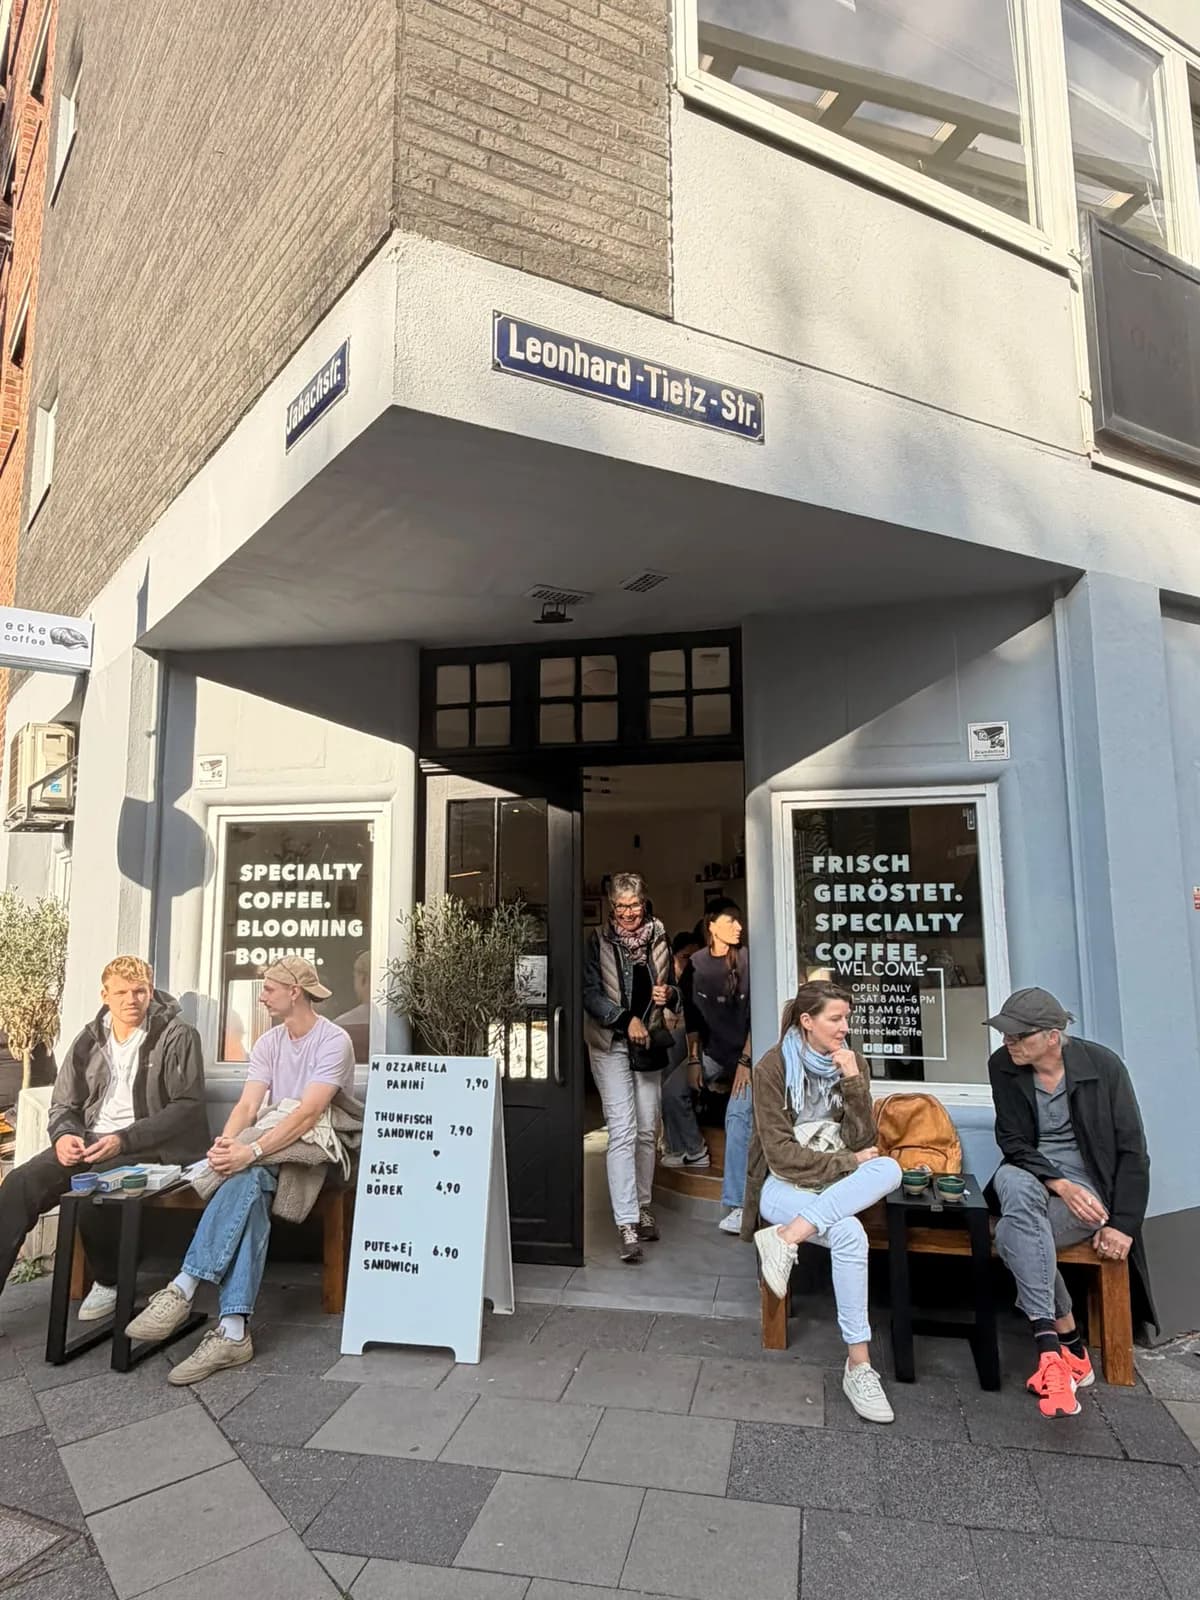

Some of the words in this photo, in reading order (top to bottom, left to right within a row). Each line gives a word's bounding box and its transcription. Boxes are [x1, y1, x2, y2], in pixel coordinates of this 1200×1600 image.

[509, 322, 758, 429] Leonhard-Tietz-Str.
[5, 622, 47, 635] ecke
[4, 634, 46, 646] coffee
[812, 854, 910, 873] FRISCH
[239, 863, 363, 882] SPECIALTY
[814, 878, 963, 903] GERÖSTET.
[238, 891, 331, 909] COFFEE.
[236, 919, 363, 938] BLOOMING
[815, 913, 964, 932] SPECIALTY
[815, 942, 928, 962] COFFEE.
[836, 961, 925, 977] WELCOME
[851, 983, 880, 993] OPEN
[882, 984, 912, 993] DAILY
[880, 995, 887, 1004] 8
[920, 995, 936, 1005] PM
[868, 1005, 875, 1014] 9
[876, 1006, 894, 1014] AM
[895, 1006, 902, 1015] 6
[904, 1006, 920, 1015] PM
[868, 1015, 918, 1026] 82477135
[375, 1111, 432, 1125] THUNFISCH
[377, 1128, 433, 1141] SANDWICH
[370, 1161, 398, 1175] KÄSE
[363, 1259, 419, 1274] SANDWICH
